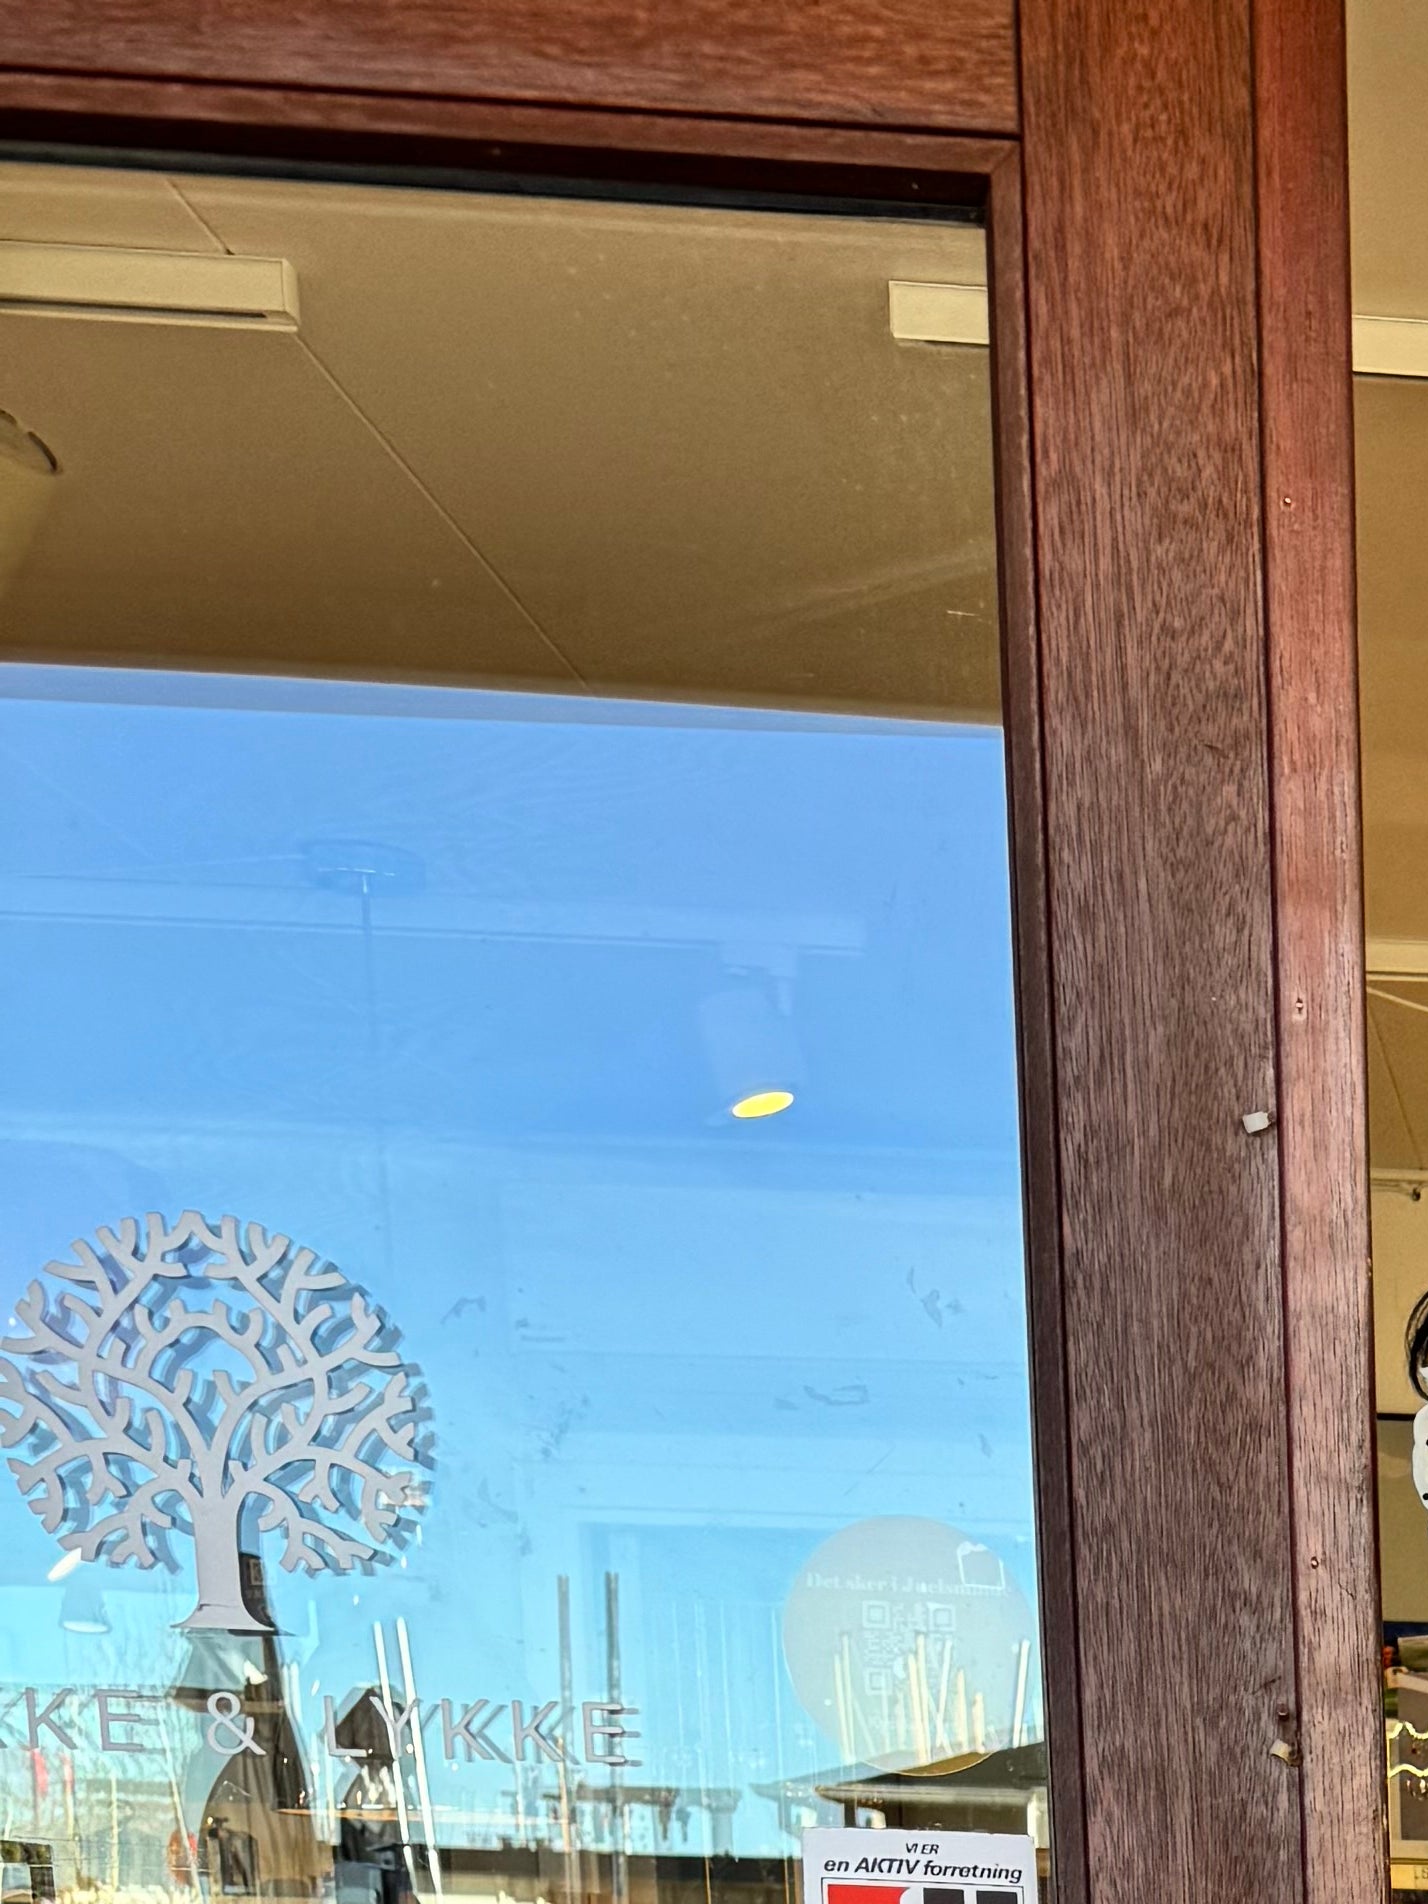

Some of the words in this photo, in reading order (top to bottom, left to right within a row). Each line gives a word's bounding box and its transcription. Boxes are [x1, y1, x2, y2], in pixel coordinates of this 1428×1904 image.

[0, 1686, 145, 1754] KE
[206, 1690, 267, 1758] &
[322, 1694, 628, 1765] LYKKE
[905, 1842, 918, 1854] VI
[921, 1843, 940, 1855] ER
[824, 1859, 850, 1873] en
[854, 1857, 920, 1875] AKTIV
[923, 1860, 1023, 1884] forretning
